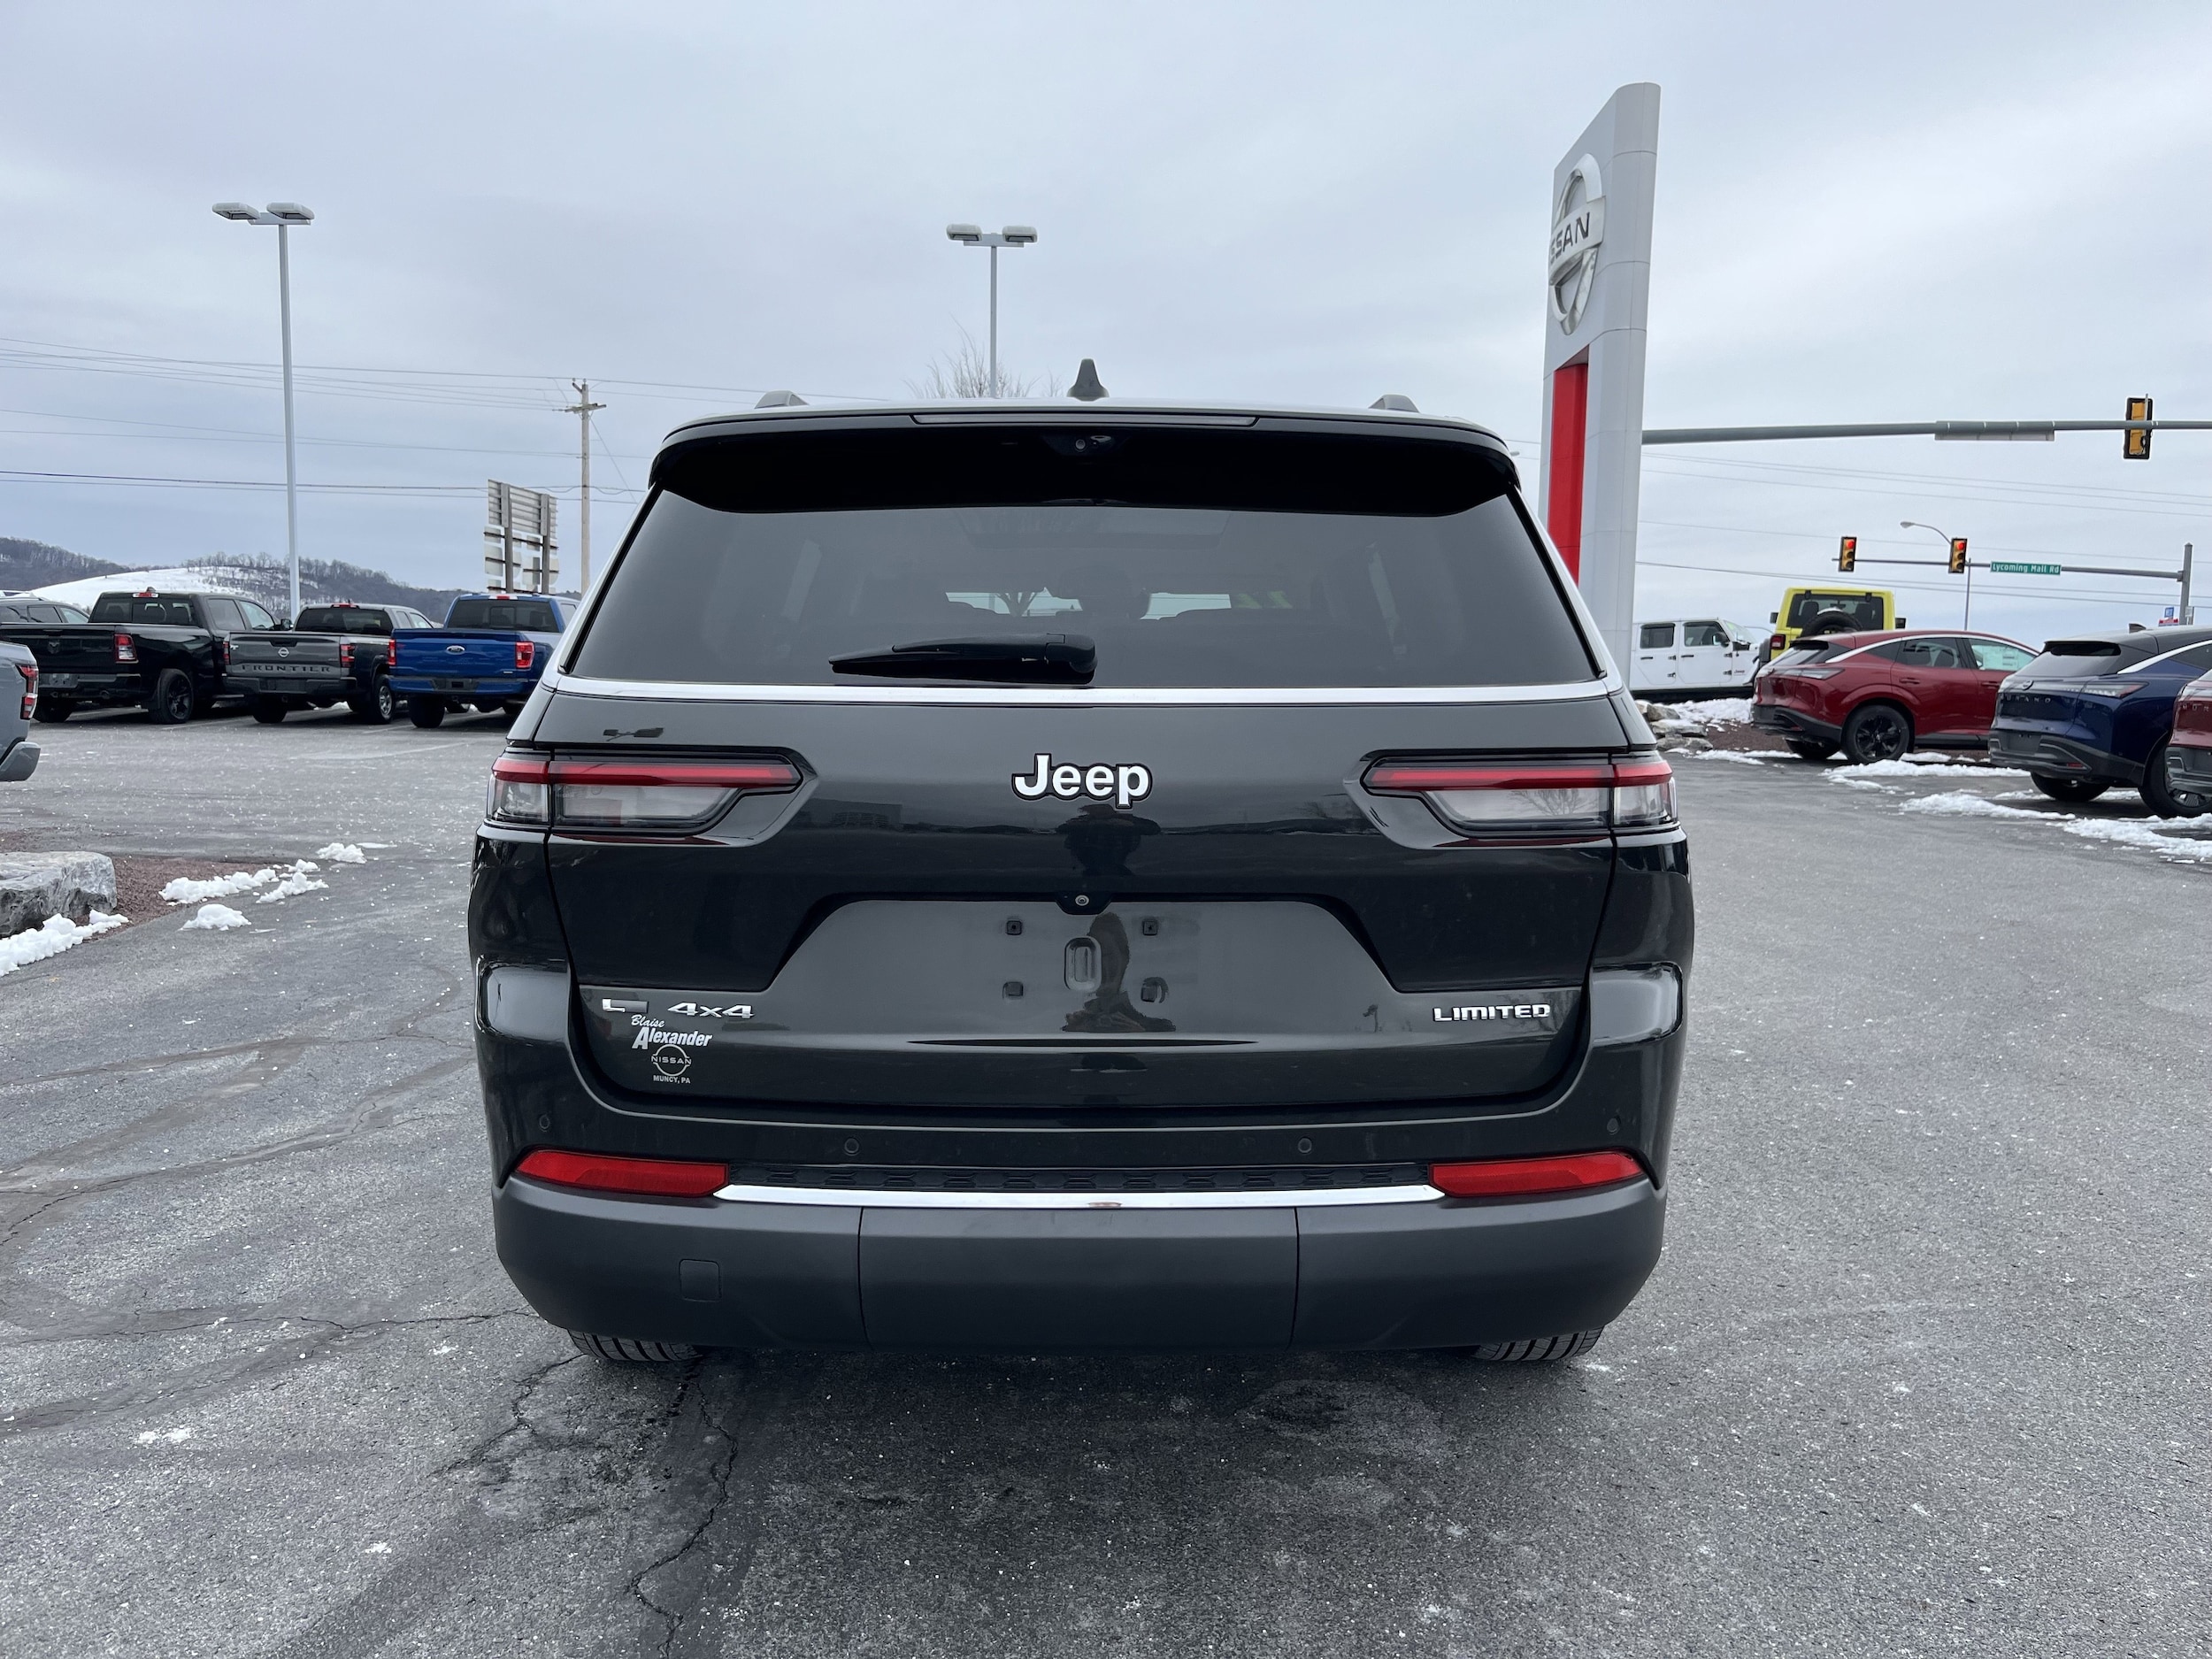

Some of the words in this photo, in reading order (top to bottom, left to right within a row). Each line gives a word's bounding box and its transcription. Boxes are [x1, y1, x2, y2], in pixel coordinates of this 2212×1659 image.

[1993, 563, 2028, 573] Lycoming
[2031, 565, 2047, 573] Mall
[1014, 754, 1149, 807] Jeep
[668, 1002, 755, 1018] 4x4
[1433, 1004, 1550, 1021] LIMITED
[631, 1014, 664, 1028] Blaise
[632, 1027, 713, 1049] Alexander
[651, 1056, 692, 1065] NISSAN
[653, 1075, 680, 1084] MUNCY,
